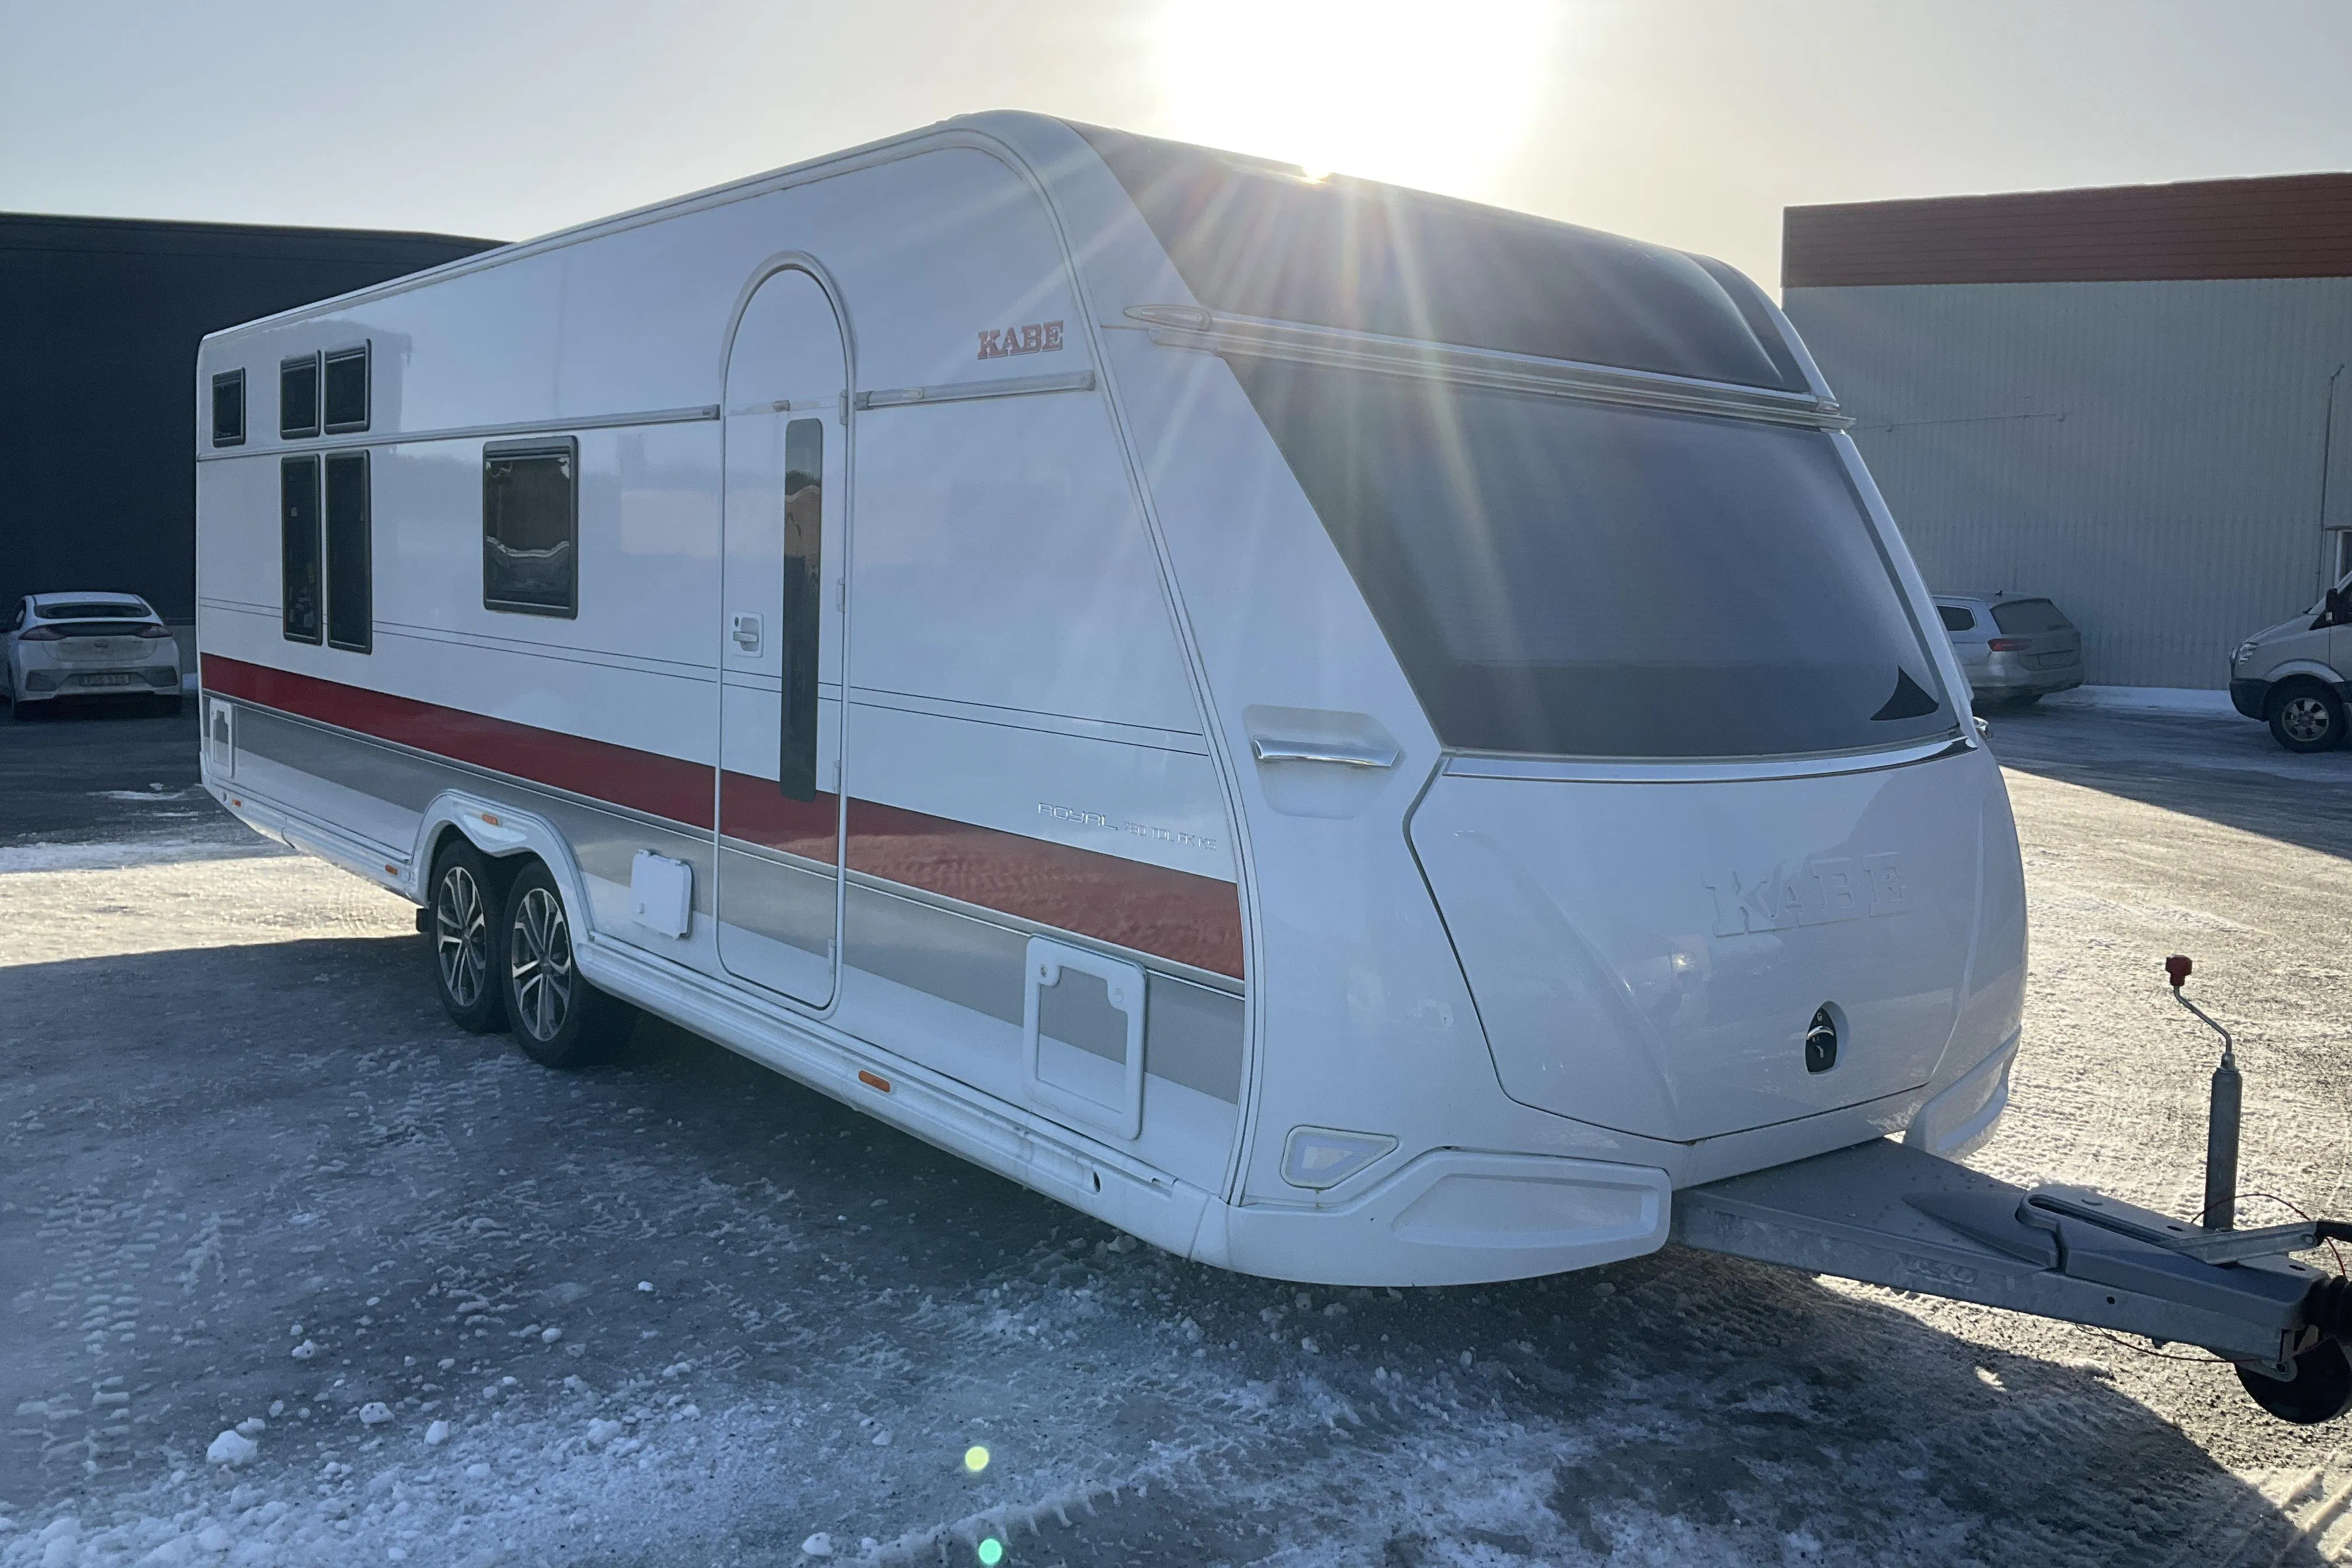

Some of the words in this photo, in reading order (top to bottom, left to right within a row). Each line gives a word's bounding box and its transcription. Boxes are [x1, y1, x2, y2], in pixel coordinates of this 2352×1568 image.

[977, 320, 1063, 359] KABE
[1038, 802, 1118, 831] ROYAL
[1150, 825, 1174, 842] TDL
[1700, 852, 1911, 939] KABE
